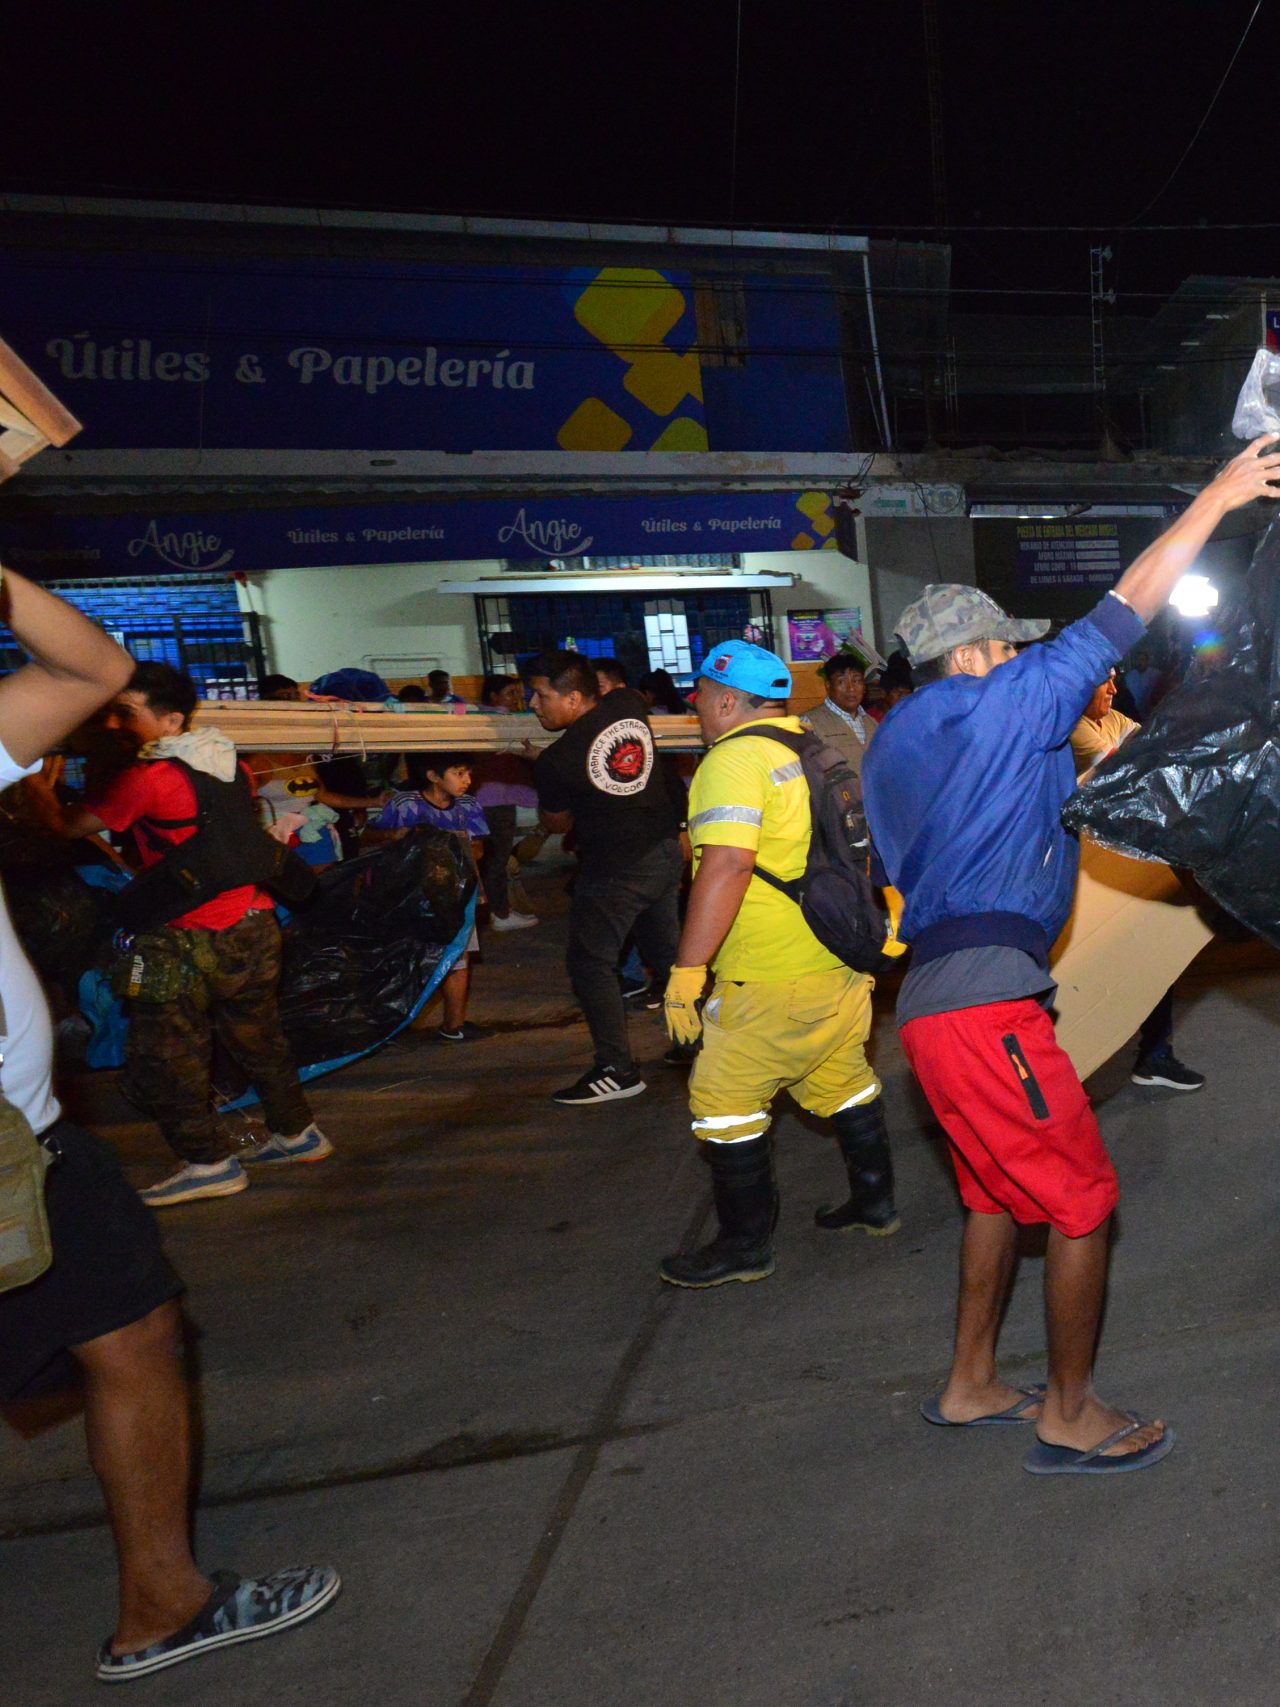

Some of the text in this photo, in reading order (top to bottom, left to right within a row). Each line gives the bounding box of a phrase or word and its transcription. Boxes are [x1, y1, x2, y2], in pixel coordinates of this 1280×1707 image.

[46, 331, 536, 394] Útiles & Papelería
[287, 524, 445, 545] Útiles & Papelería
[498, 508, 588, 553] Angie
[641, 516, 781, 534] Útiles & Papelería
[128, 519, 229, 568] Angie
[605, 781, 645, 793] VOLCOM
